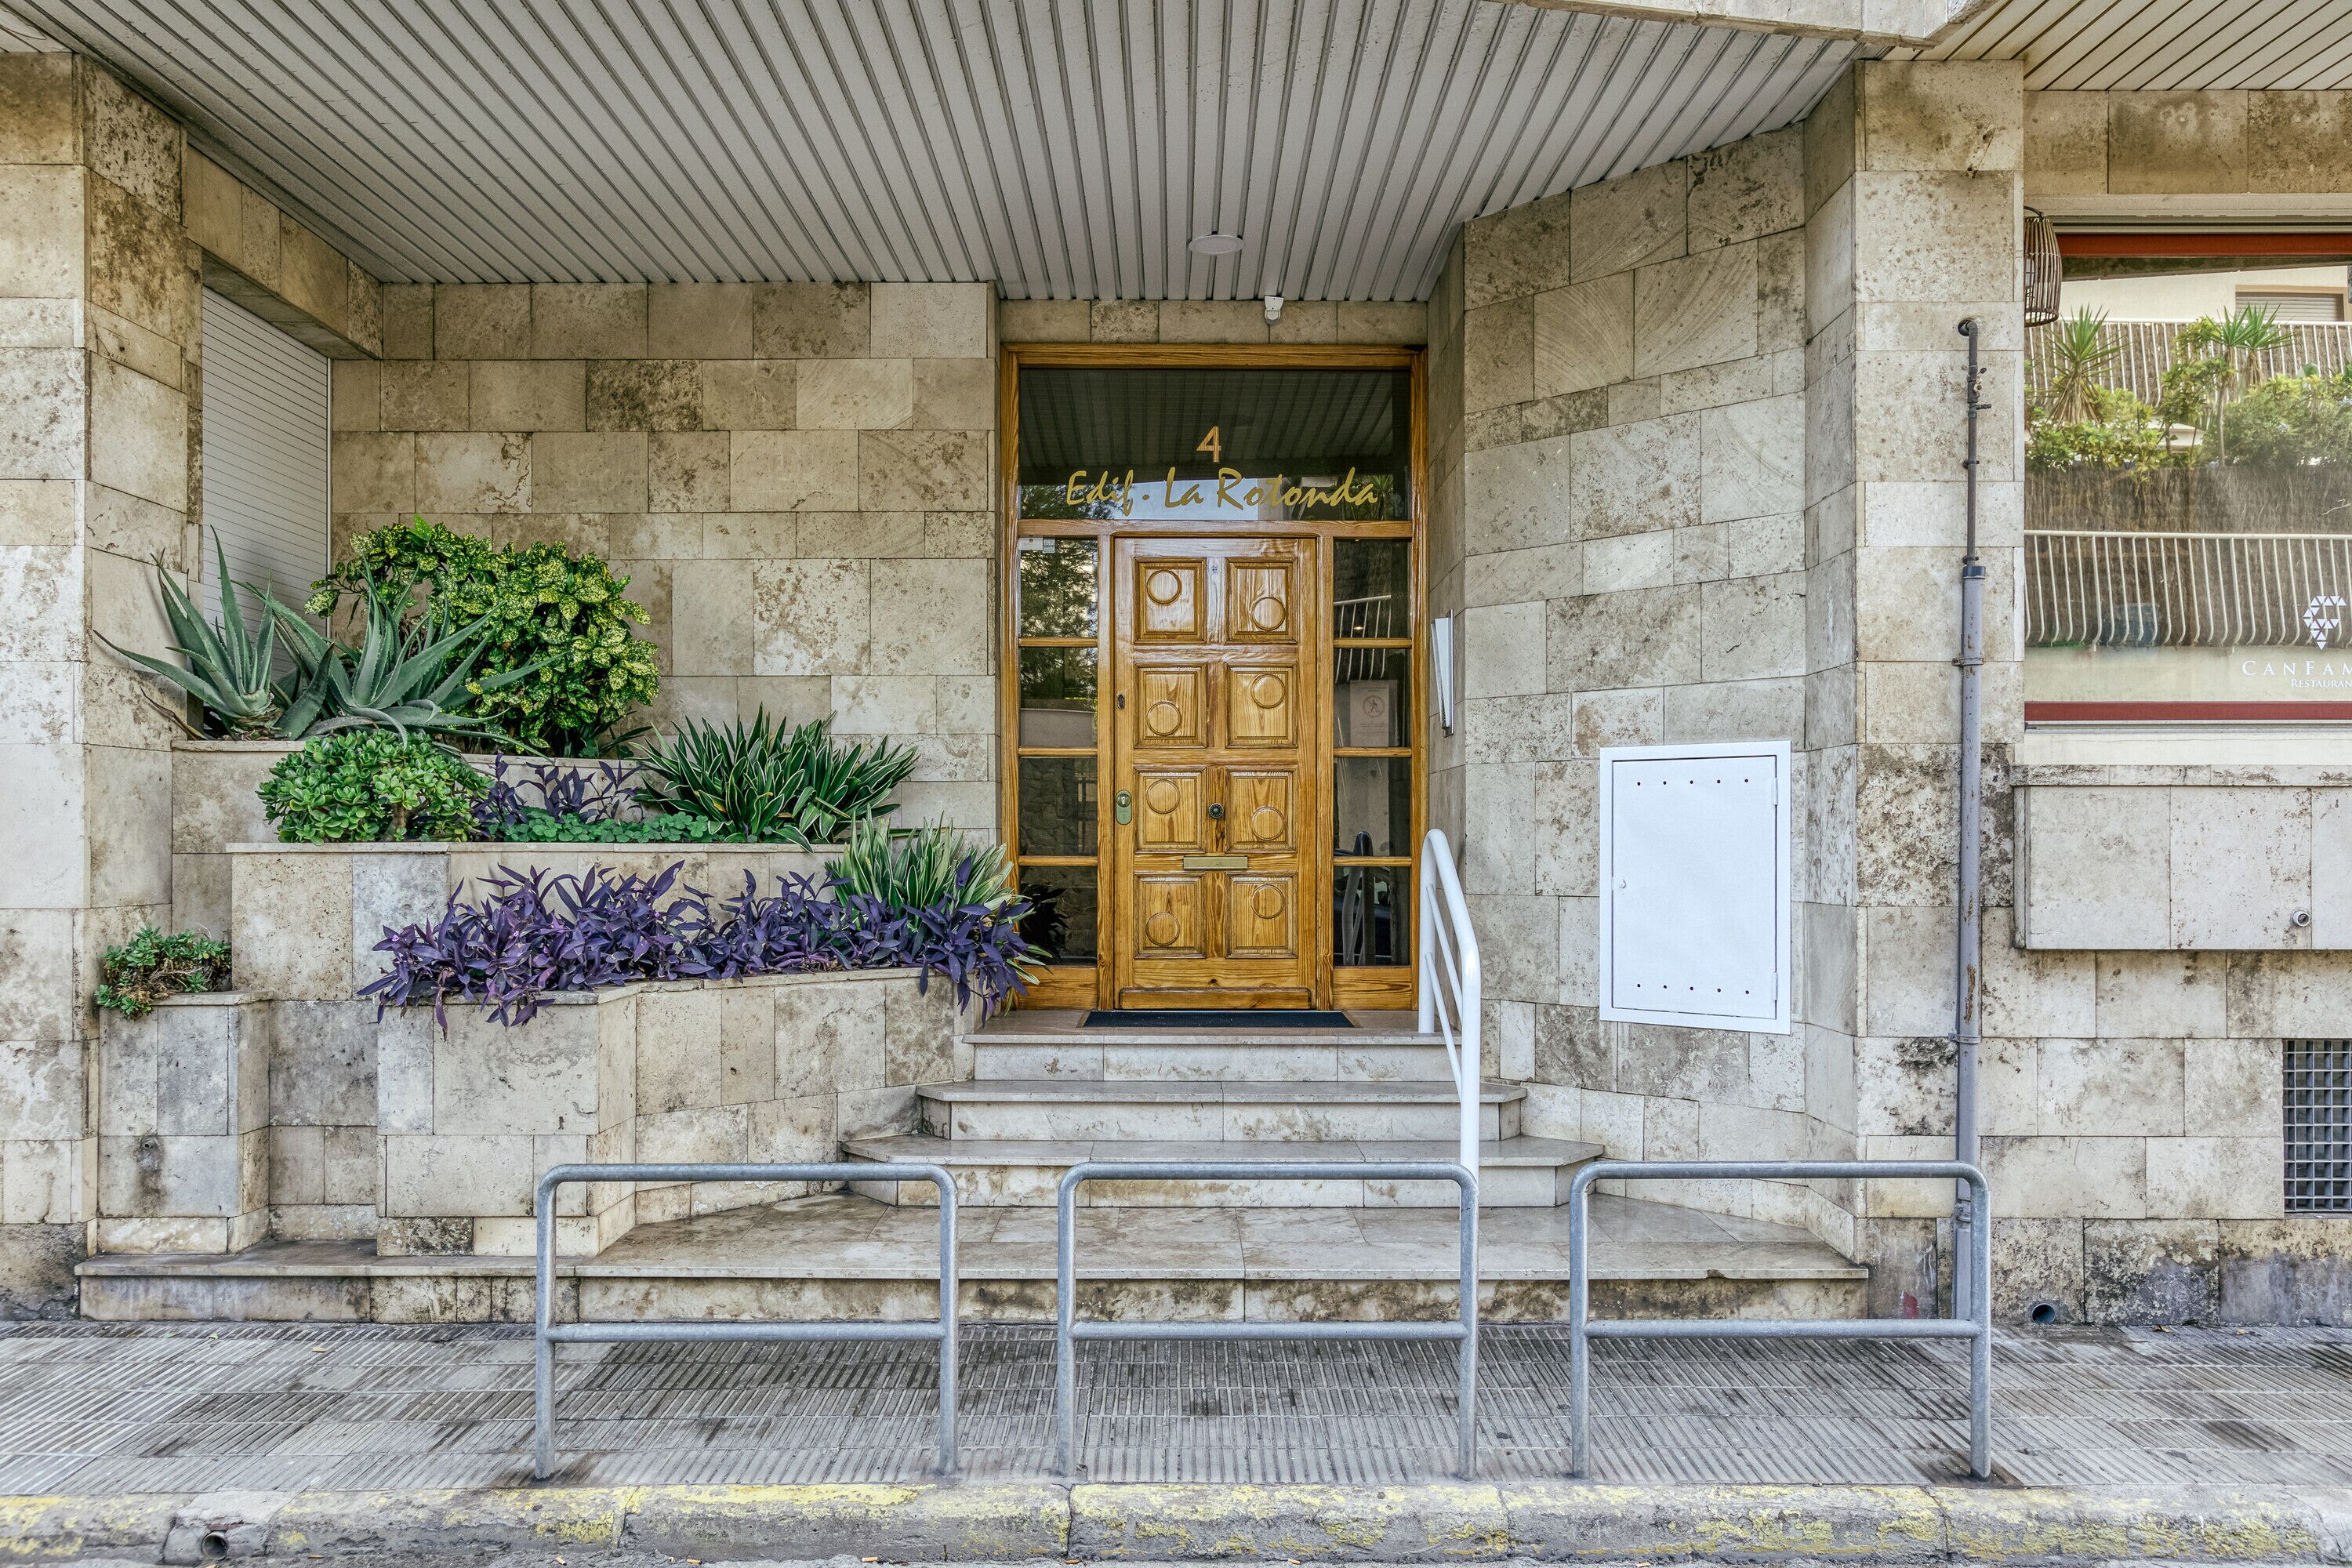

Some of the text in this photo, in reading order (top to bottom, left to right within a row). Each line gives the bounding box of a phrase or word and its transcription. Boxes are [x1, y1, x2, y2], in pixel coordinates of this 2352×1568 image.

[1196, 426, 1221, 463] 4
[1164, 466, 1204, 508] La
[1217, 466, 1378, 510] Rotonda
